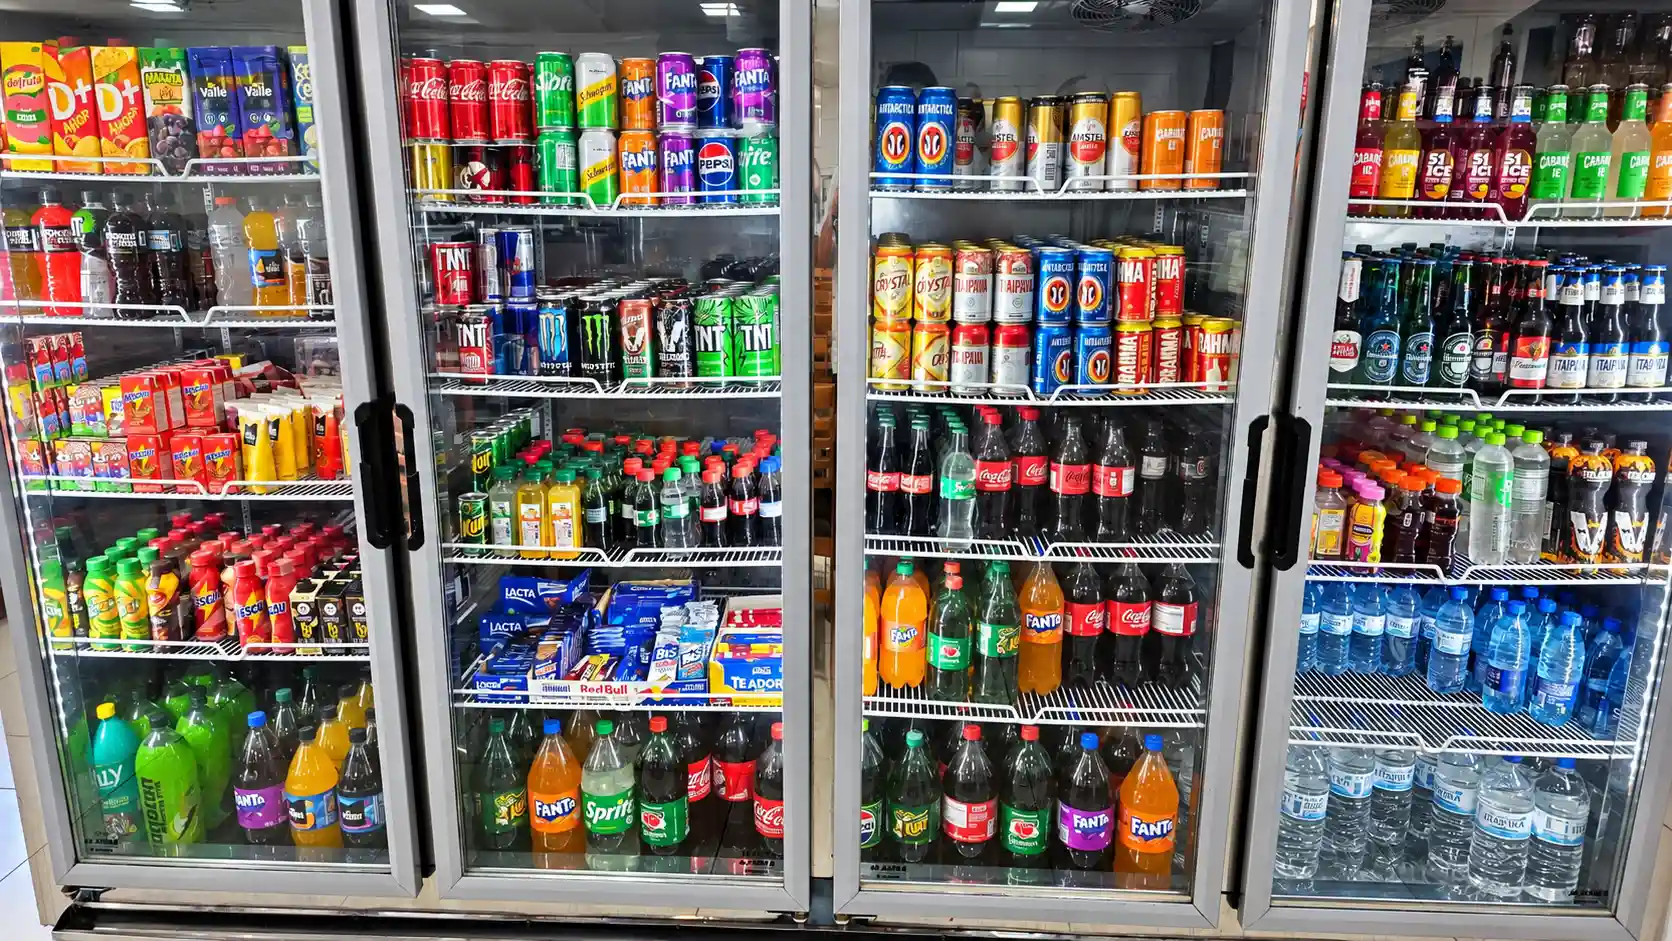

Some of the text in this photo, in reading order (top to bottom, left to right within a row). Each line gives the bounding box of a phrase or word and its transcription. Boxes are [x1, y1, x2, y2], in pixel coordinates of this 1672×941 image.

[200, 86, 228, 98] Valle
[244, 85, 273, 97] Valle
[48, 78, 92, 120] D+
[95, 79, 140, 120] D+
[878, 103, 914, 115] ANTARCTICA
[1071, 132, 1104, 142] AMSTEL
[1428, 152, 1446, 165] 51
[1472, 152, 1490, 165] 51
[1503, 152, 1522, 165] 51
[1427, 165, 1452, 177] ICE
[1501, 165, 1530, 177] ICE
[437, 247, 471, 272] TNT
[740, 323, 773, 351] TNT
[505, 587, 536, 600] LACTA
[490, 621, 523, 635] LACTA
[1026, 613, 1062, 630] FANTA
[655, 647, 678, 660] BIS
[731, 676, 747, 689] TE
[580, 684, 603, 694] Red
[605, 684, 628, 695] Bull
[535, 796, 576, 818] FANTA
[1072, 814, 1109, 830] FANTA
[1131, 816, 1173, 837] FANTA
